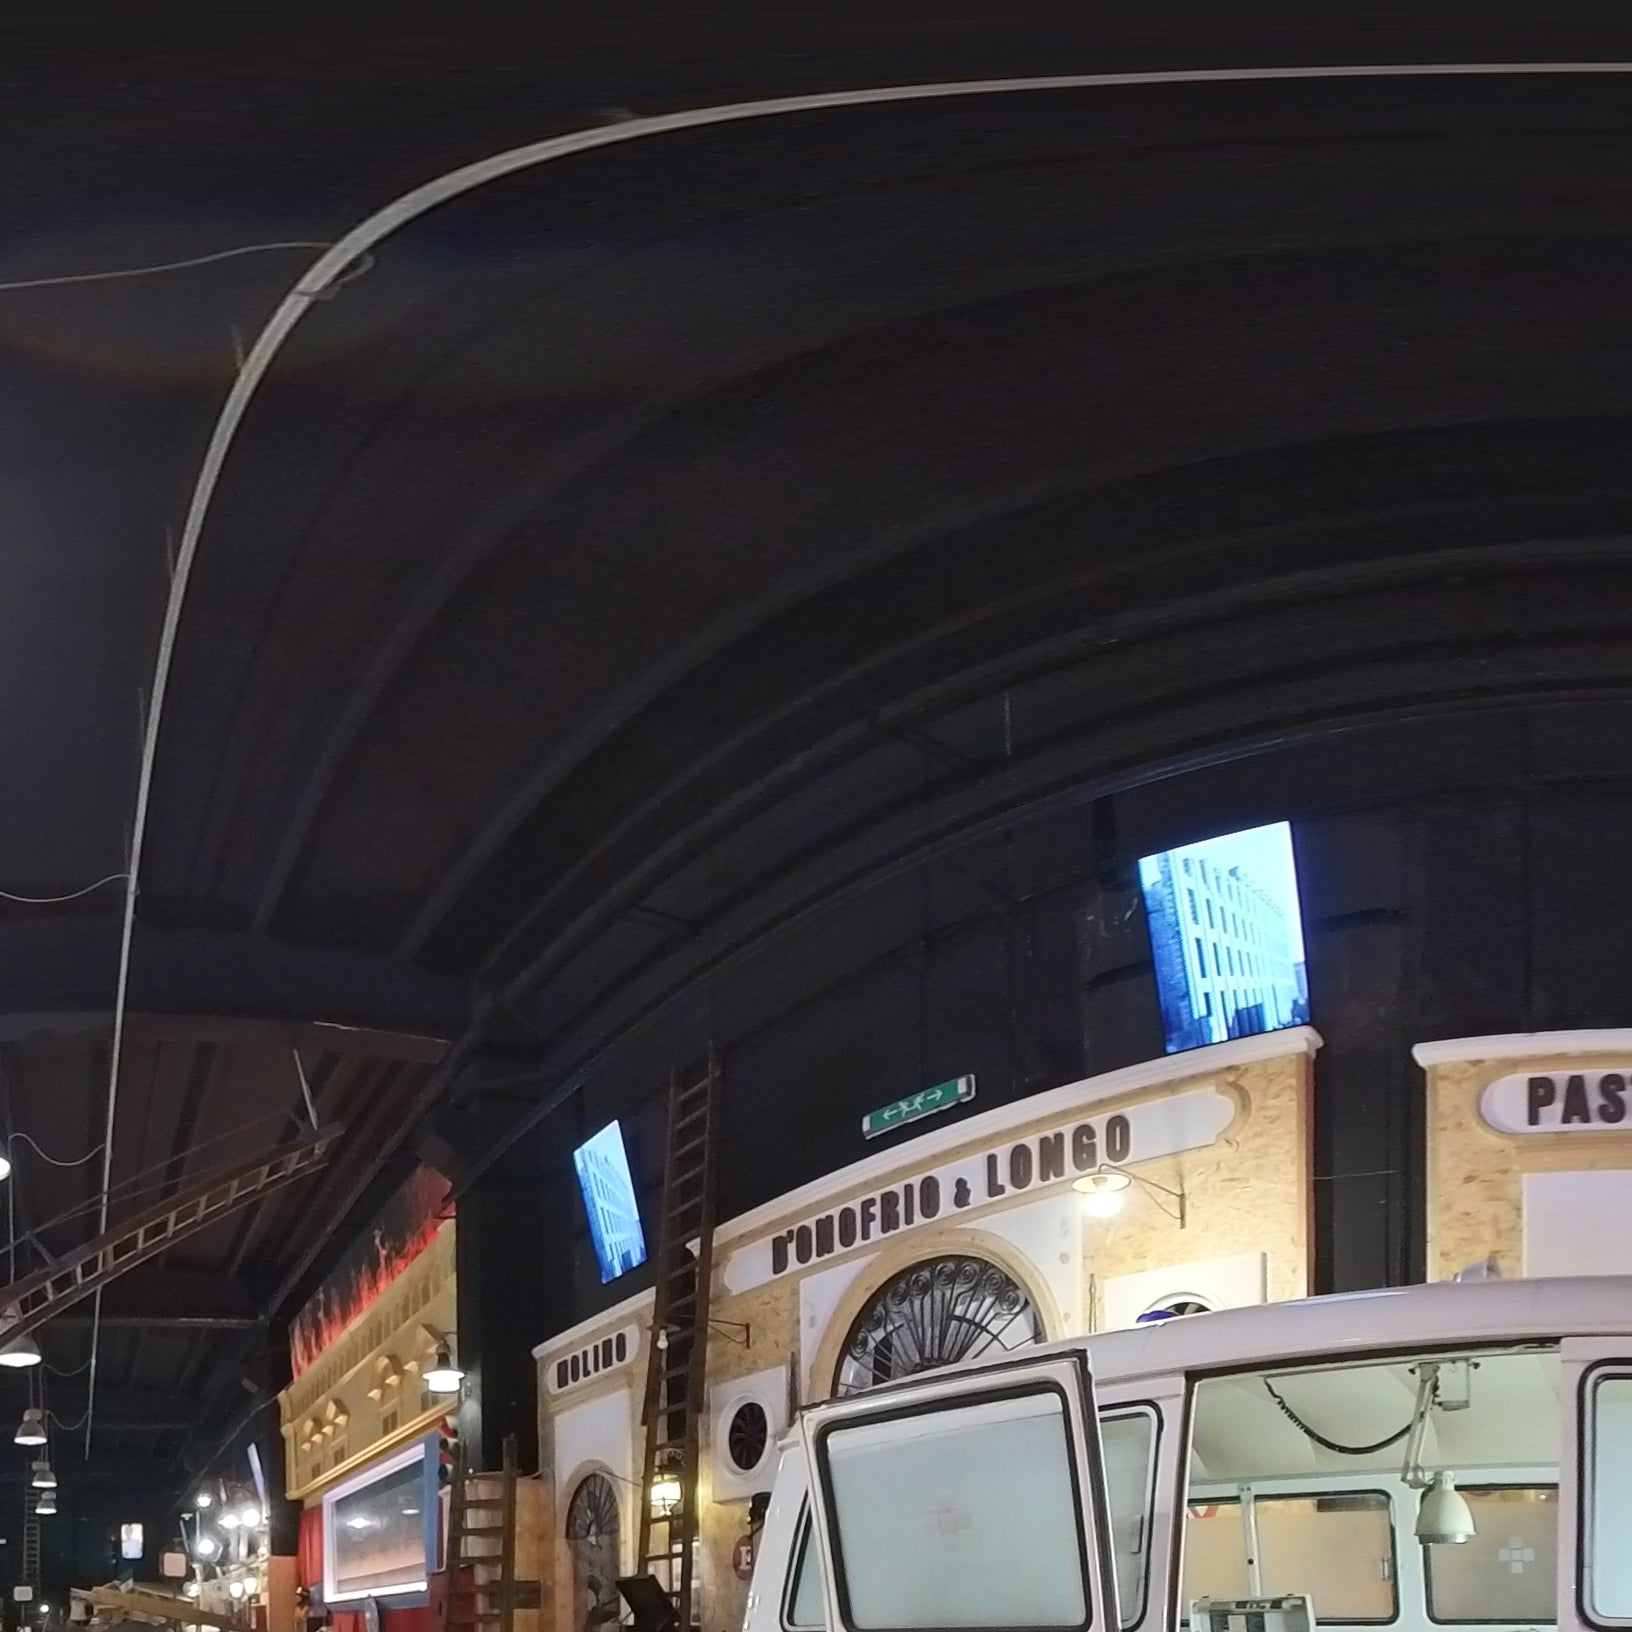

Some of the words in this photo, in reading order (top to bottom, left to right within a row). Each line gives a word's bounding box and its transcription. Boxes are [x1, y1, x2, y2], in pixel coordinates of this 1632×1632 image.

[772, 1175, 940, 1275] D'ONOFRIO
[953, 1177, 972, 1208] &
[986, 1115, 1130, 1198] LONGO
[557, 1332, 626, 1389] MOLINO
